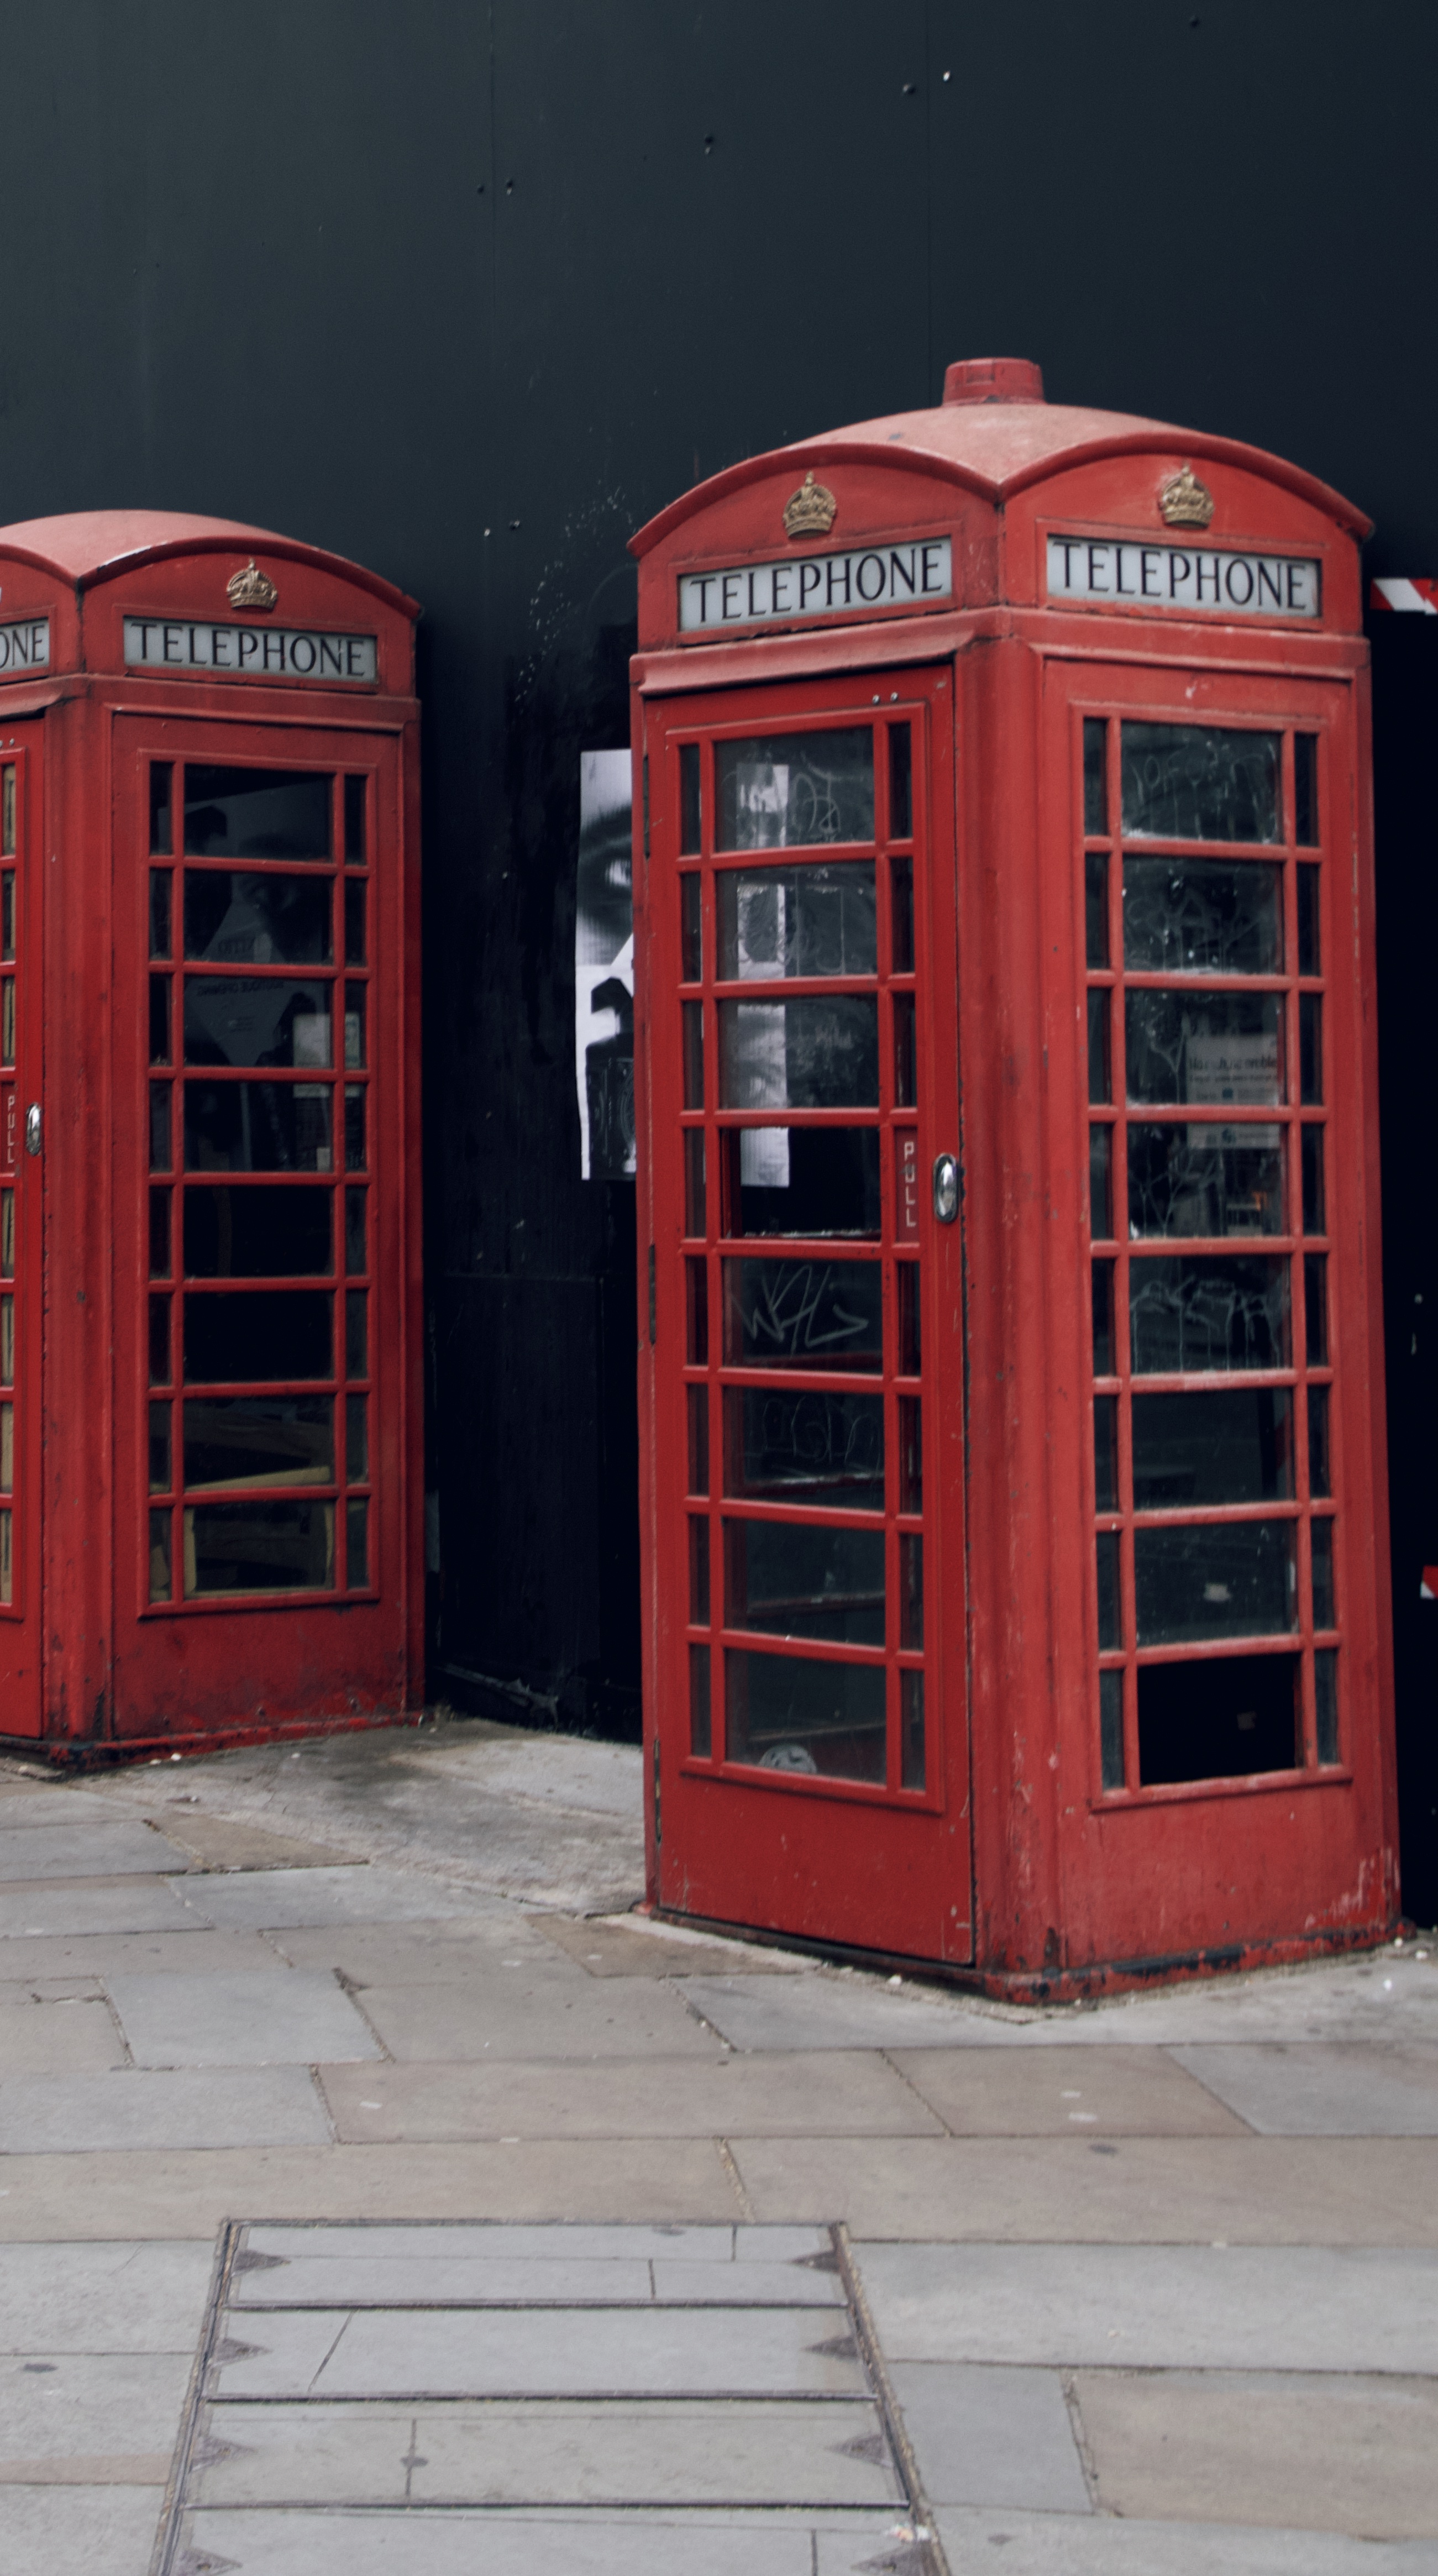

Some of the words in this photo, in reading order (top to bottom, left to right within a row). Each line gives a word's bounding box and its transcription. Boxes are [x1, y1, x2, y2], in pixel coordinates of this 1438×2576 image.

[690, 544, 943, 623] TELEPHONE
[1052, 542, 1308, 610] TELEPHONE
[131, 622, 365, 677] TELEPHONE
[7, 1095, 15, 1164] PULL
[904, 1141, 917, 1227] PULL
